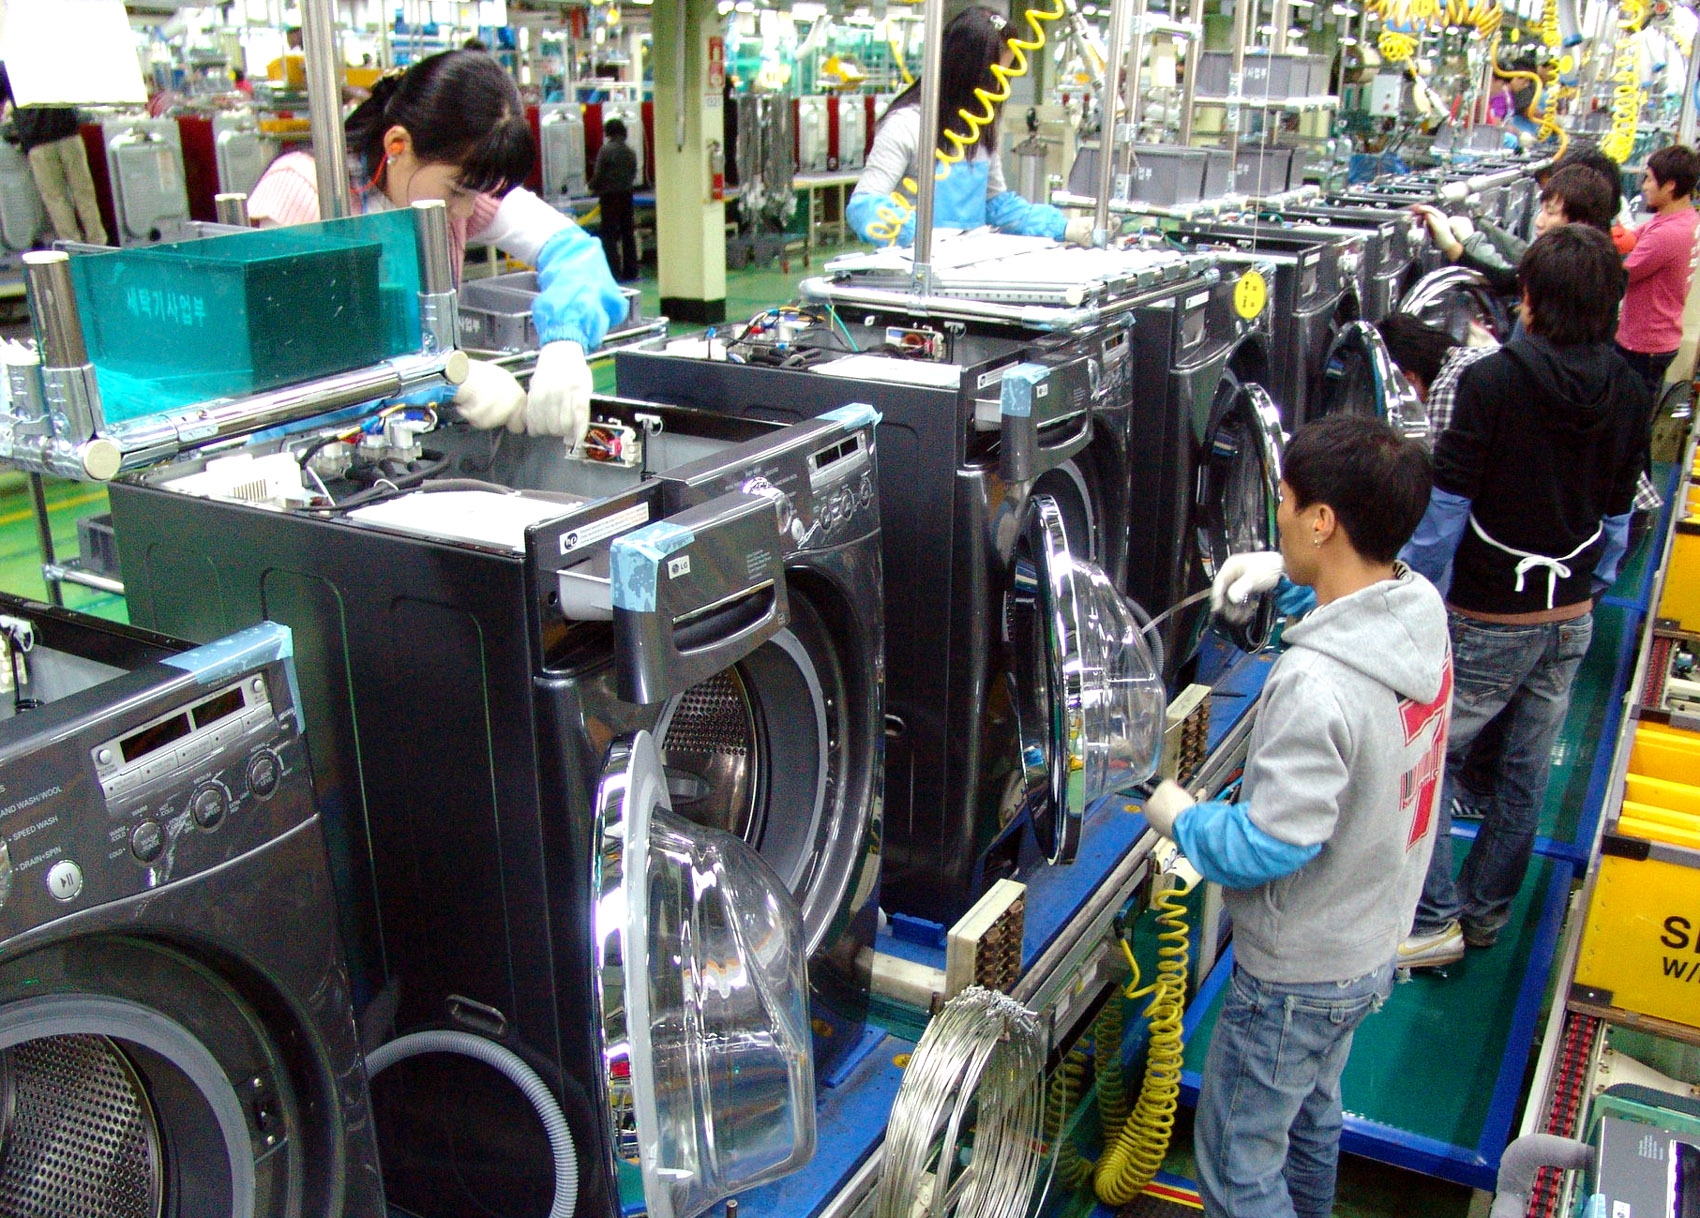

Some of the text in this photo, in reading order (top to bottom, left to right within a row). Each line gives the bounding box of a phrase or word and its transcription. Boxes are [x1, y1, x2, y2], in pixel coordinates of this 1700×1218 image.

[16, 785, 62, 811] WASH/WOOL
[12, 815, 59, 842] SPEED WASH
[1662, 956, 1700, 984] W/
